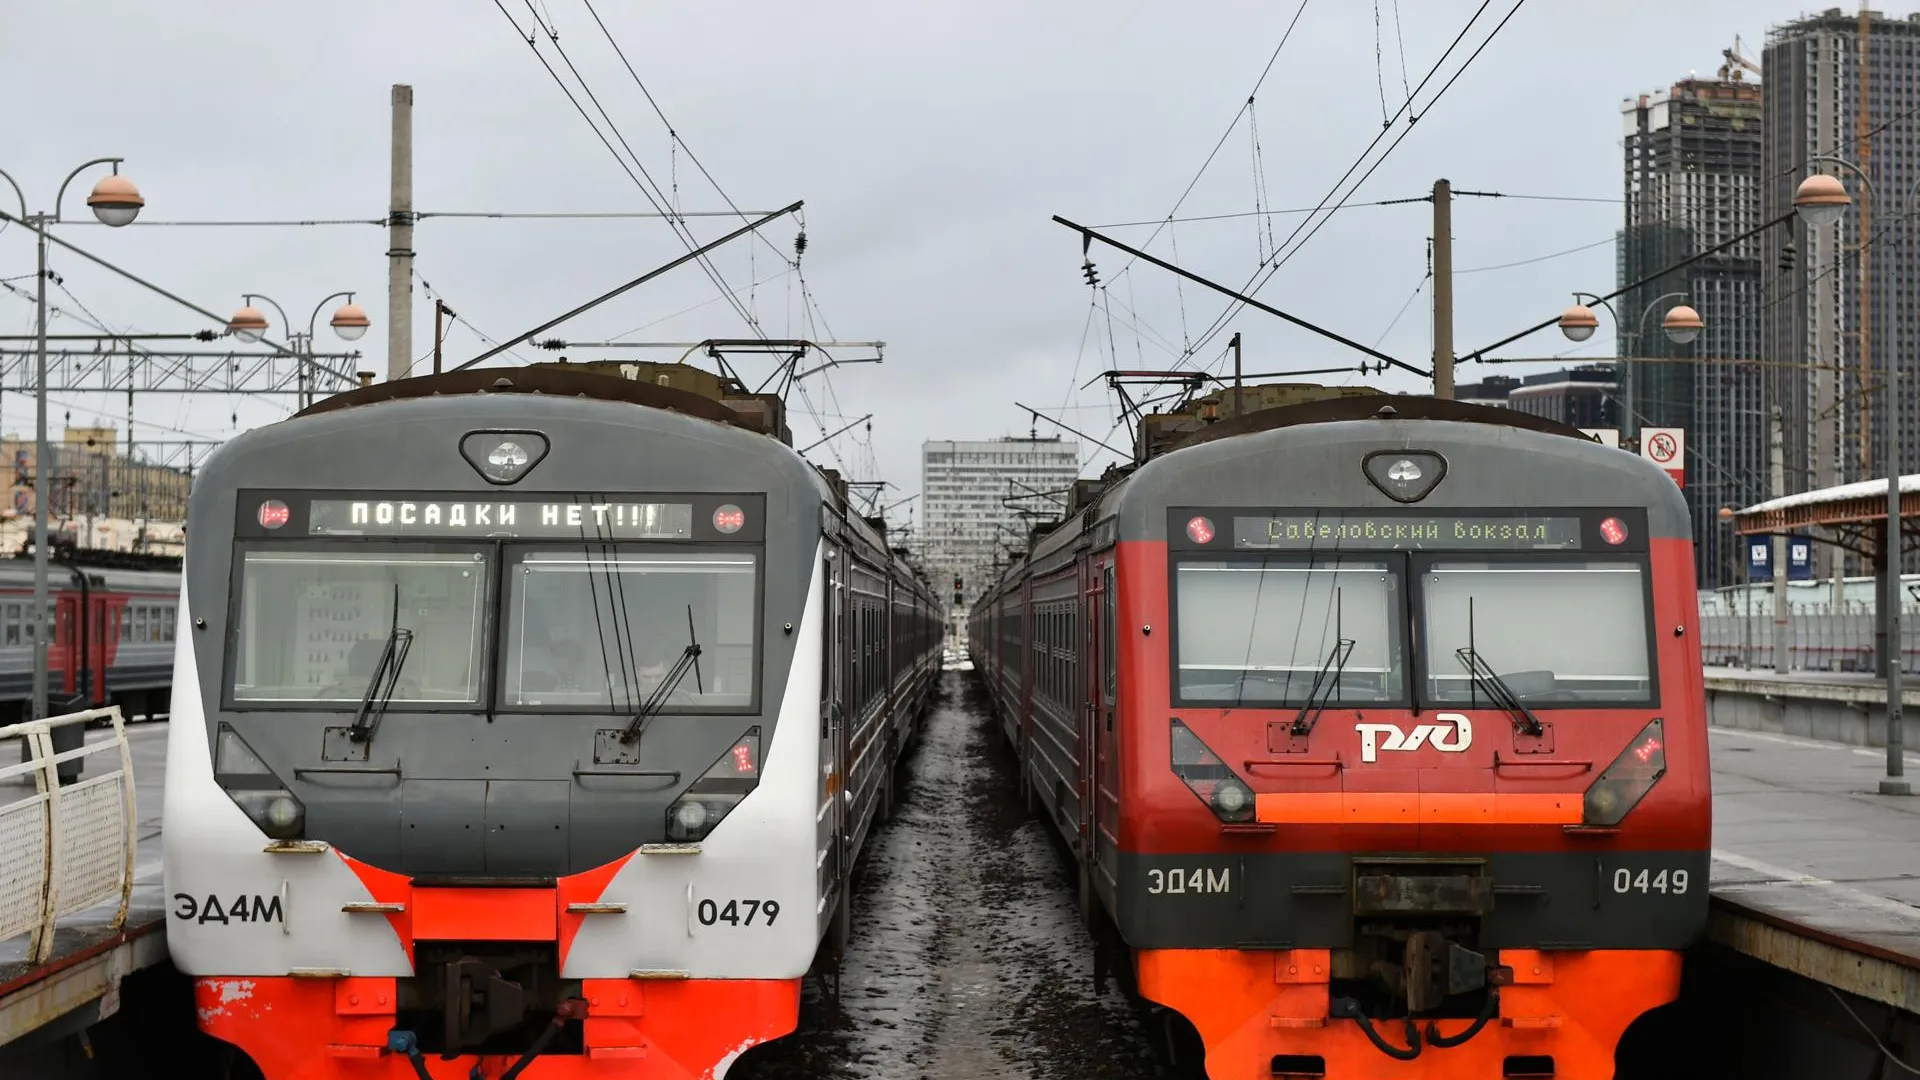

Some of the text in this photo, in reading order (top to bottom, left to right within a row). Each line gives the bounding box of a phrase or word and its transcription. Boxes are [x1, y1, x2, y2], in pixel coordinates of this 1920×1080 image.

[352, 502, 654, 526] ПОСАДКИ НЕТ!!!
[1268, 519, 1545, 539] Савеловский вокзал
[1147, 867, 1230, 894] ЭД4М
[1613, 868, 1689, 895] 0449
[174, 893, 284, 925] ЭД4М
[698, 898, 780, 927] 0479
